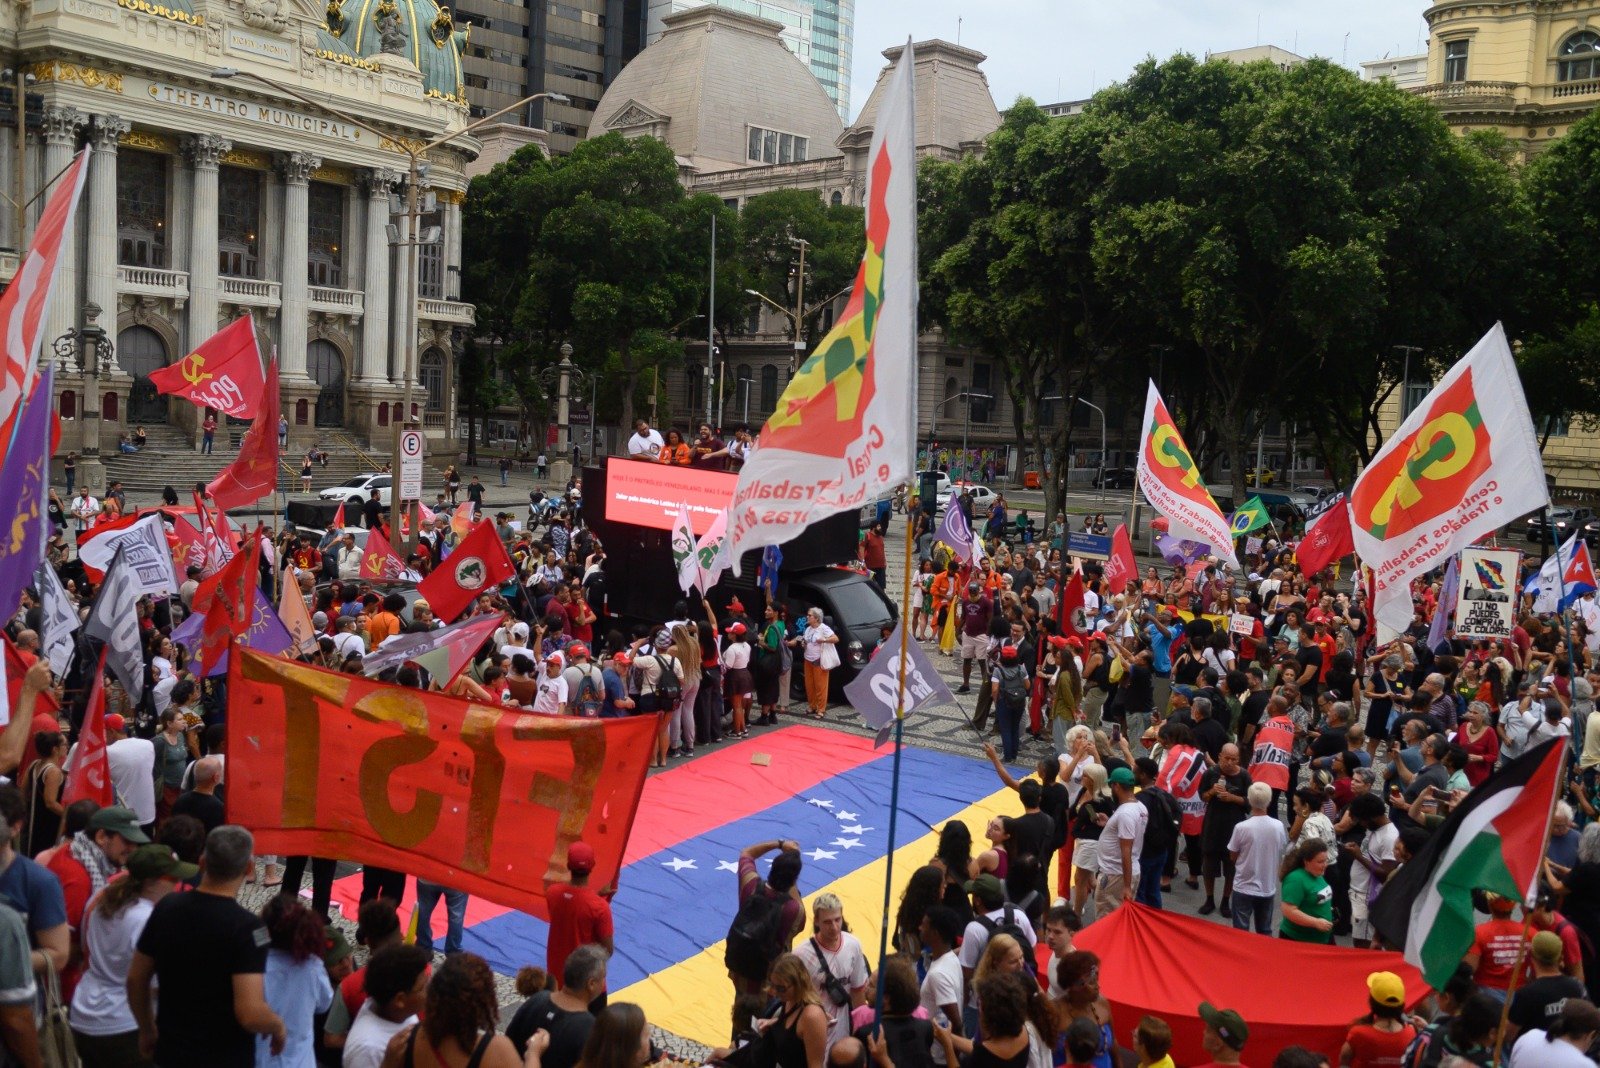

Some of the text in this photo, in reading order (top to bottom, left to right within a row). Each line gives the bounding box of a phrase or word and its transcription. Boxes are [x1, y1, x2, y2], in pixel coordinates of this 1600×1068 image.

[164, 86, 350, 138] THEATRO MUNICIPAL
[408, 438, 414, 450] E
[1161, 491, 1177, 506] dos
[1195, 525, 1208, 537] do
[1209, 534, 1232, 557] Brasil
[1472, 602, 1498, 611] TU NO
[1469, 610, 1500, 618] PUEDES
[1464, 617, 1505, 628] COMPRAR
[1457, 625, 1510, 636] LOS COLORES
